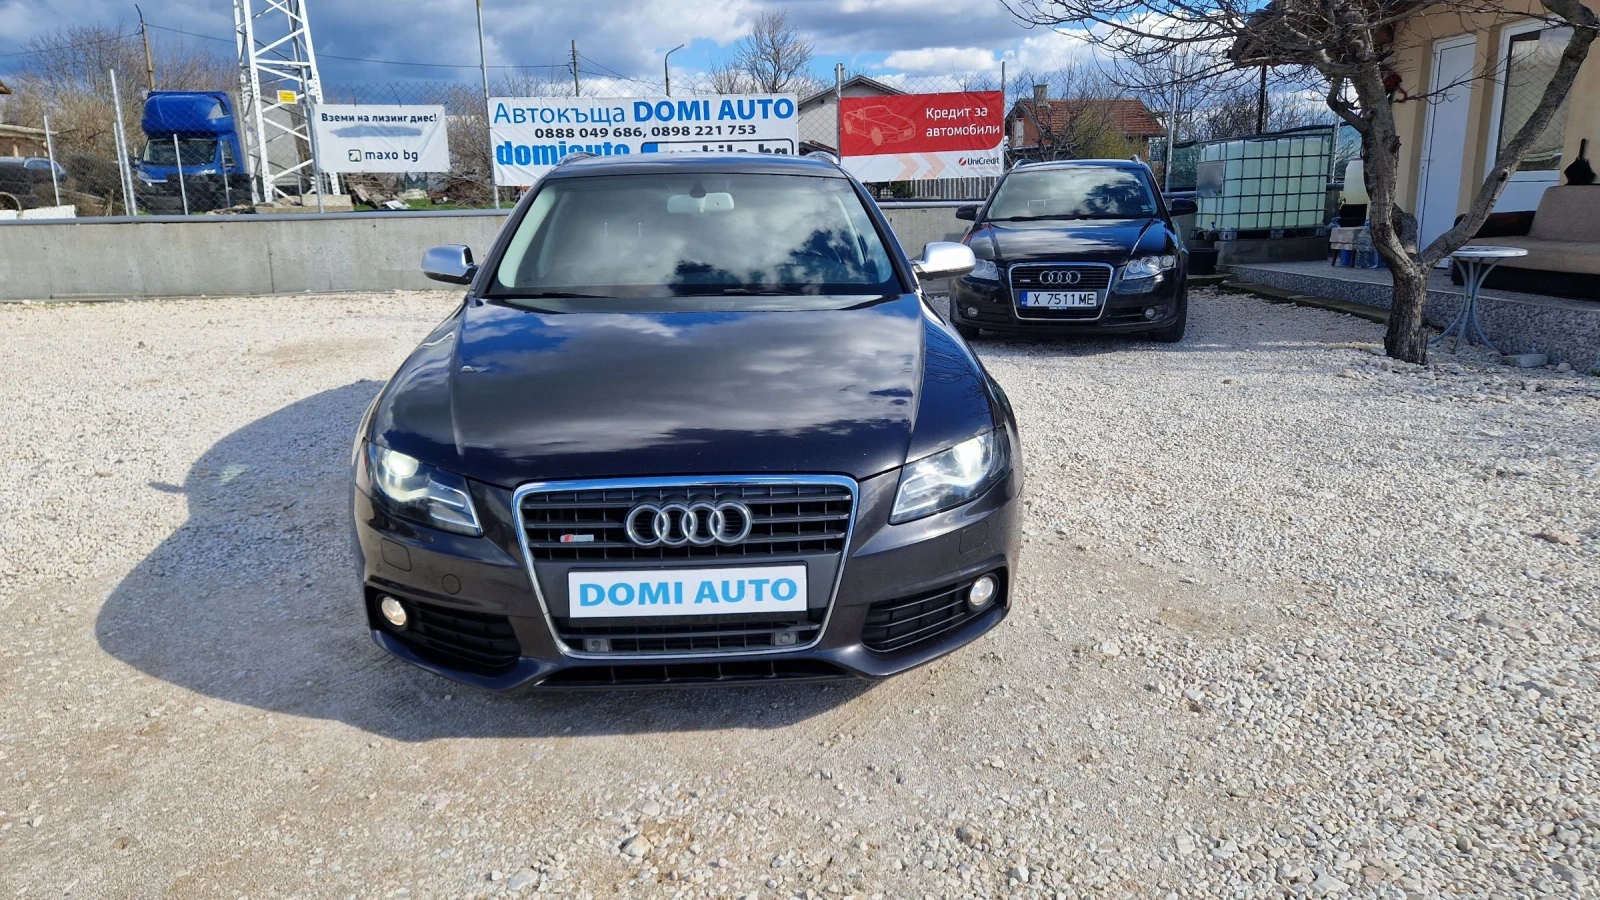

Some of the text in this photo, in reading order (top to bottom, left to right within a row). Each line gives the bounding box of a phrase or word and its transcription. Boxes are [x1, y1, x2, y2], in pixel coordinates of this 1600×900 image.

[321, 113, 437, 123] Вземи на лизинг днес!
[493, 98, 794, 127] Автокъща DOMI AUTO
[926, 107, 988, 121] Кредит за
[534, 124, 757, 139] 0888 049 686, 0898 221 753
[926, 123, 1000, 137] автомобили
[365, 149, 419, 162] maxo bg
[967, 156, 1000, 166] UniCredit
[579, 577, 798, 607] DOMI AUTO
